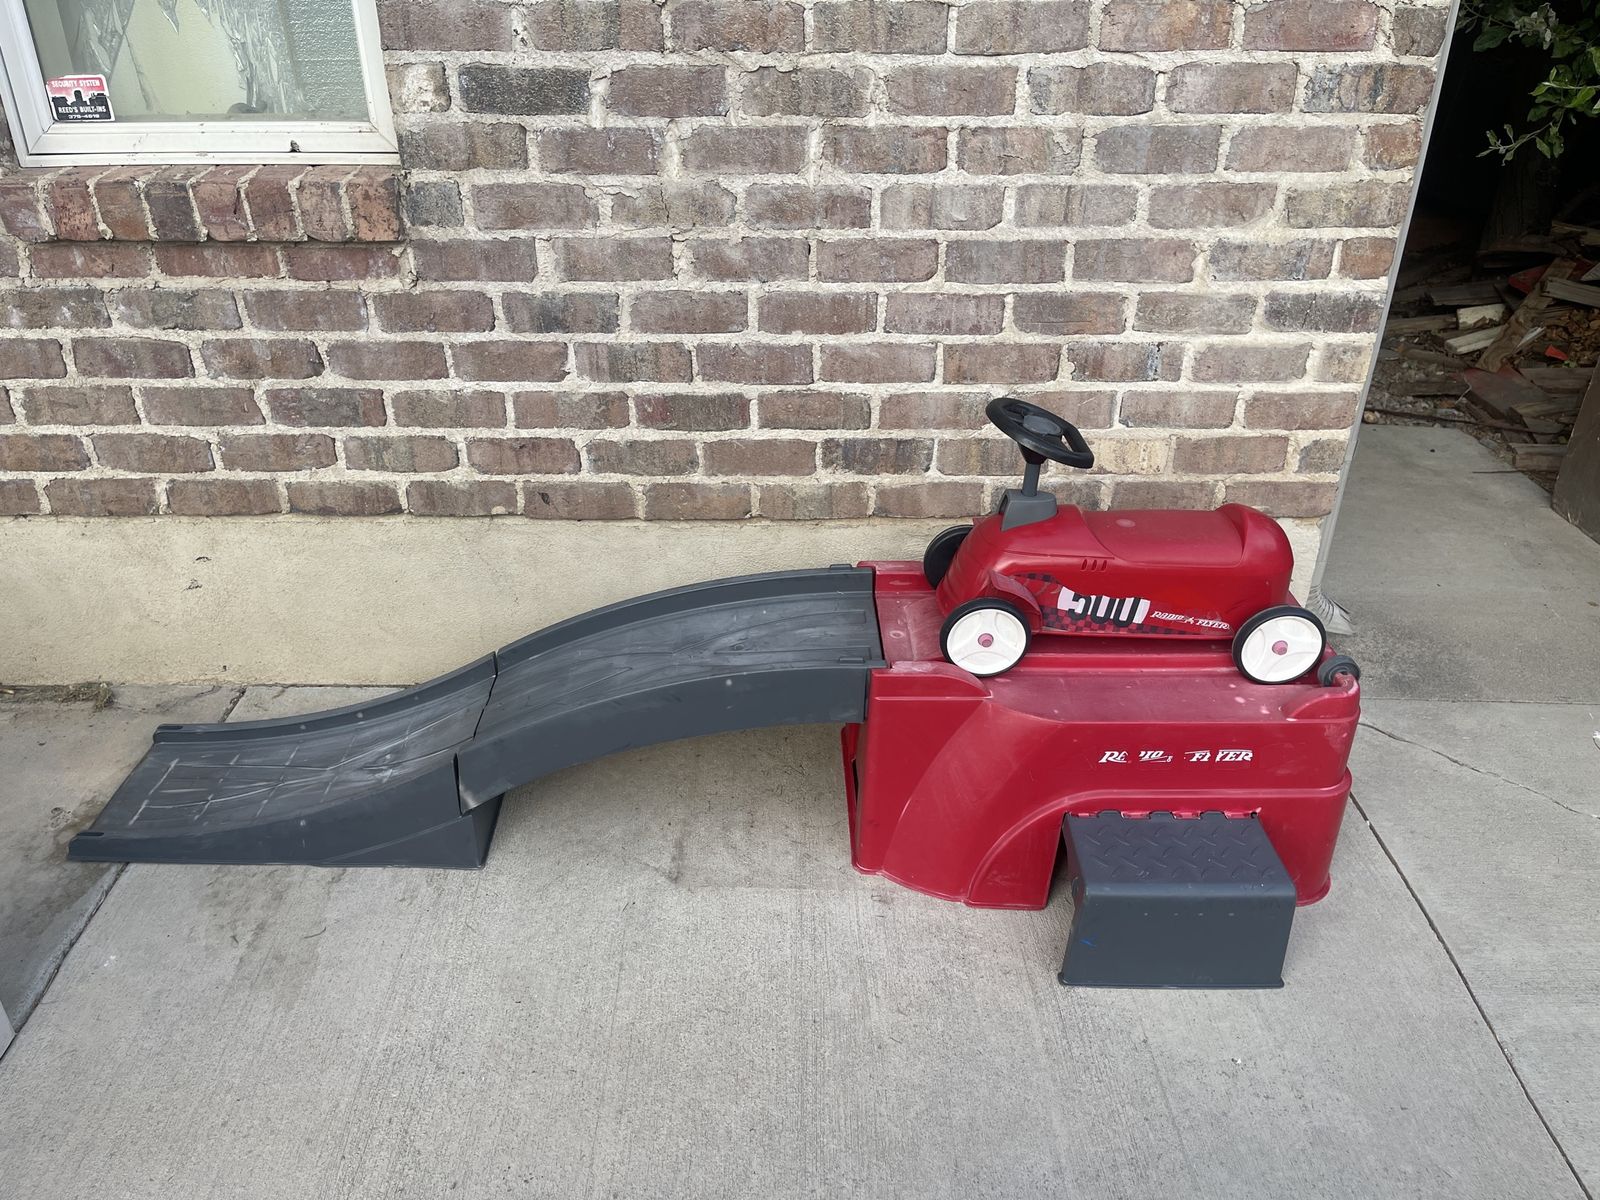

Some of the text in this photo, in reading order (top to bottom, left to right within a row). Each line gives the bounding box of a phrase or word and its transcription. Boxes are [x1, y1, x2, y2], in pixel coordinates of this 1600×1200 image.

[51, 79, 101, 88] SECURITY SYSTEM
[79, 105, 106, 113] BUILT-INS
[1150, 611, 1230, 630] RADIO FLYER
